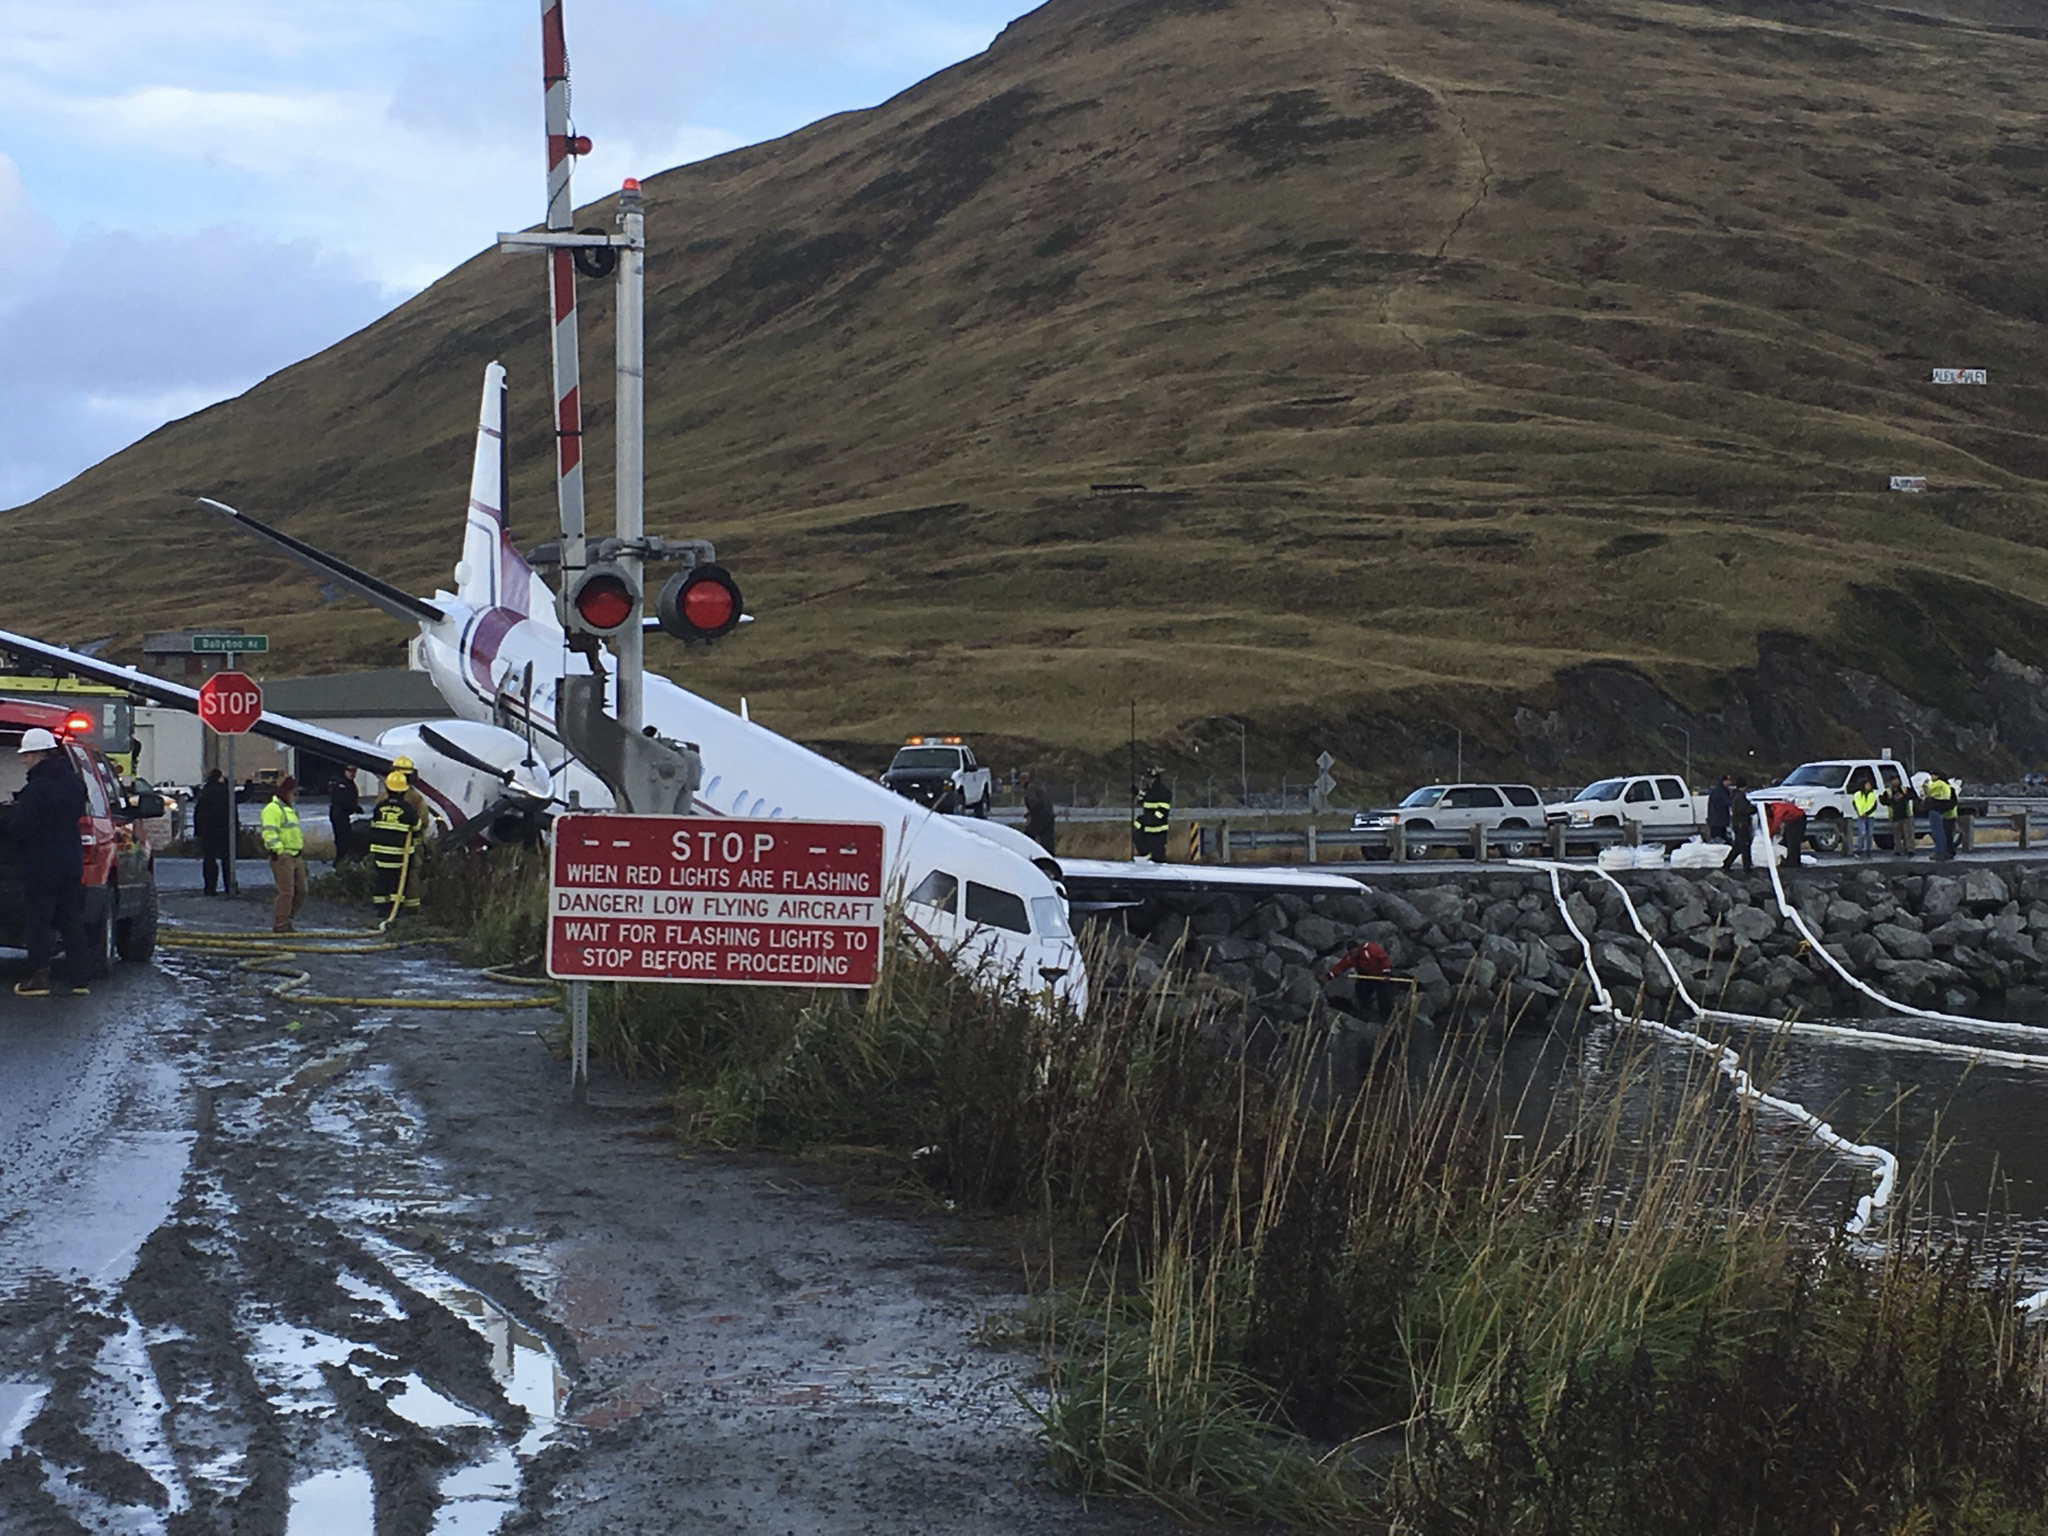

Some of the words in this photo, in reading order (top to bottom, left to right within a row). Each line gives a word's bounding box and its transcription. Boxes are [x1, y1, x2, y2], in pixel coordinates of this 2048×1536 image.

[202, 639, 243, 651] Ballyhoo
[204, 692, 258, 715] STOP
[671, 831, 775, 863] STOP
[567, 864, 618, 884] WHEN
[626, 866, 662, 885] RED
[669, 867, 730, 888] LIGHTS
[738, 869, 774, 888] ARE
[782, 870, 870, 892] FLASHING
[558, 893, 644, 914] DANGER!
[653, 896, 693, 914] LOW
[704, 897, 769, 918] FLYING
[777, 900, 875, 921] AIRCRAFT
[564, 922, 611, 942] WAIT
[619, 924, 656, 943] FOR
[665, 926, 760, 947] FLASHING
[769, 929, 835, 950] LIGHTS
[844, 931, 868, 950] TO
[583, 948, 633, 968] STOP
[641, 950, 717, 970] BEFORE
[726, 954, 849, 975] PROCEEDING
